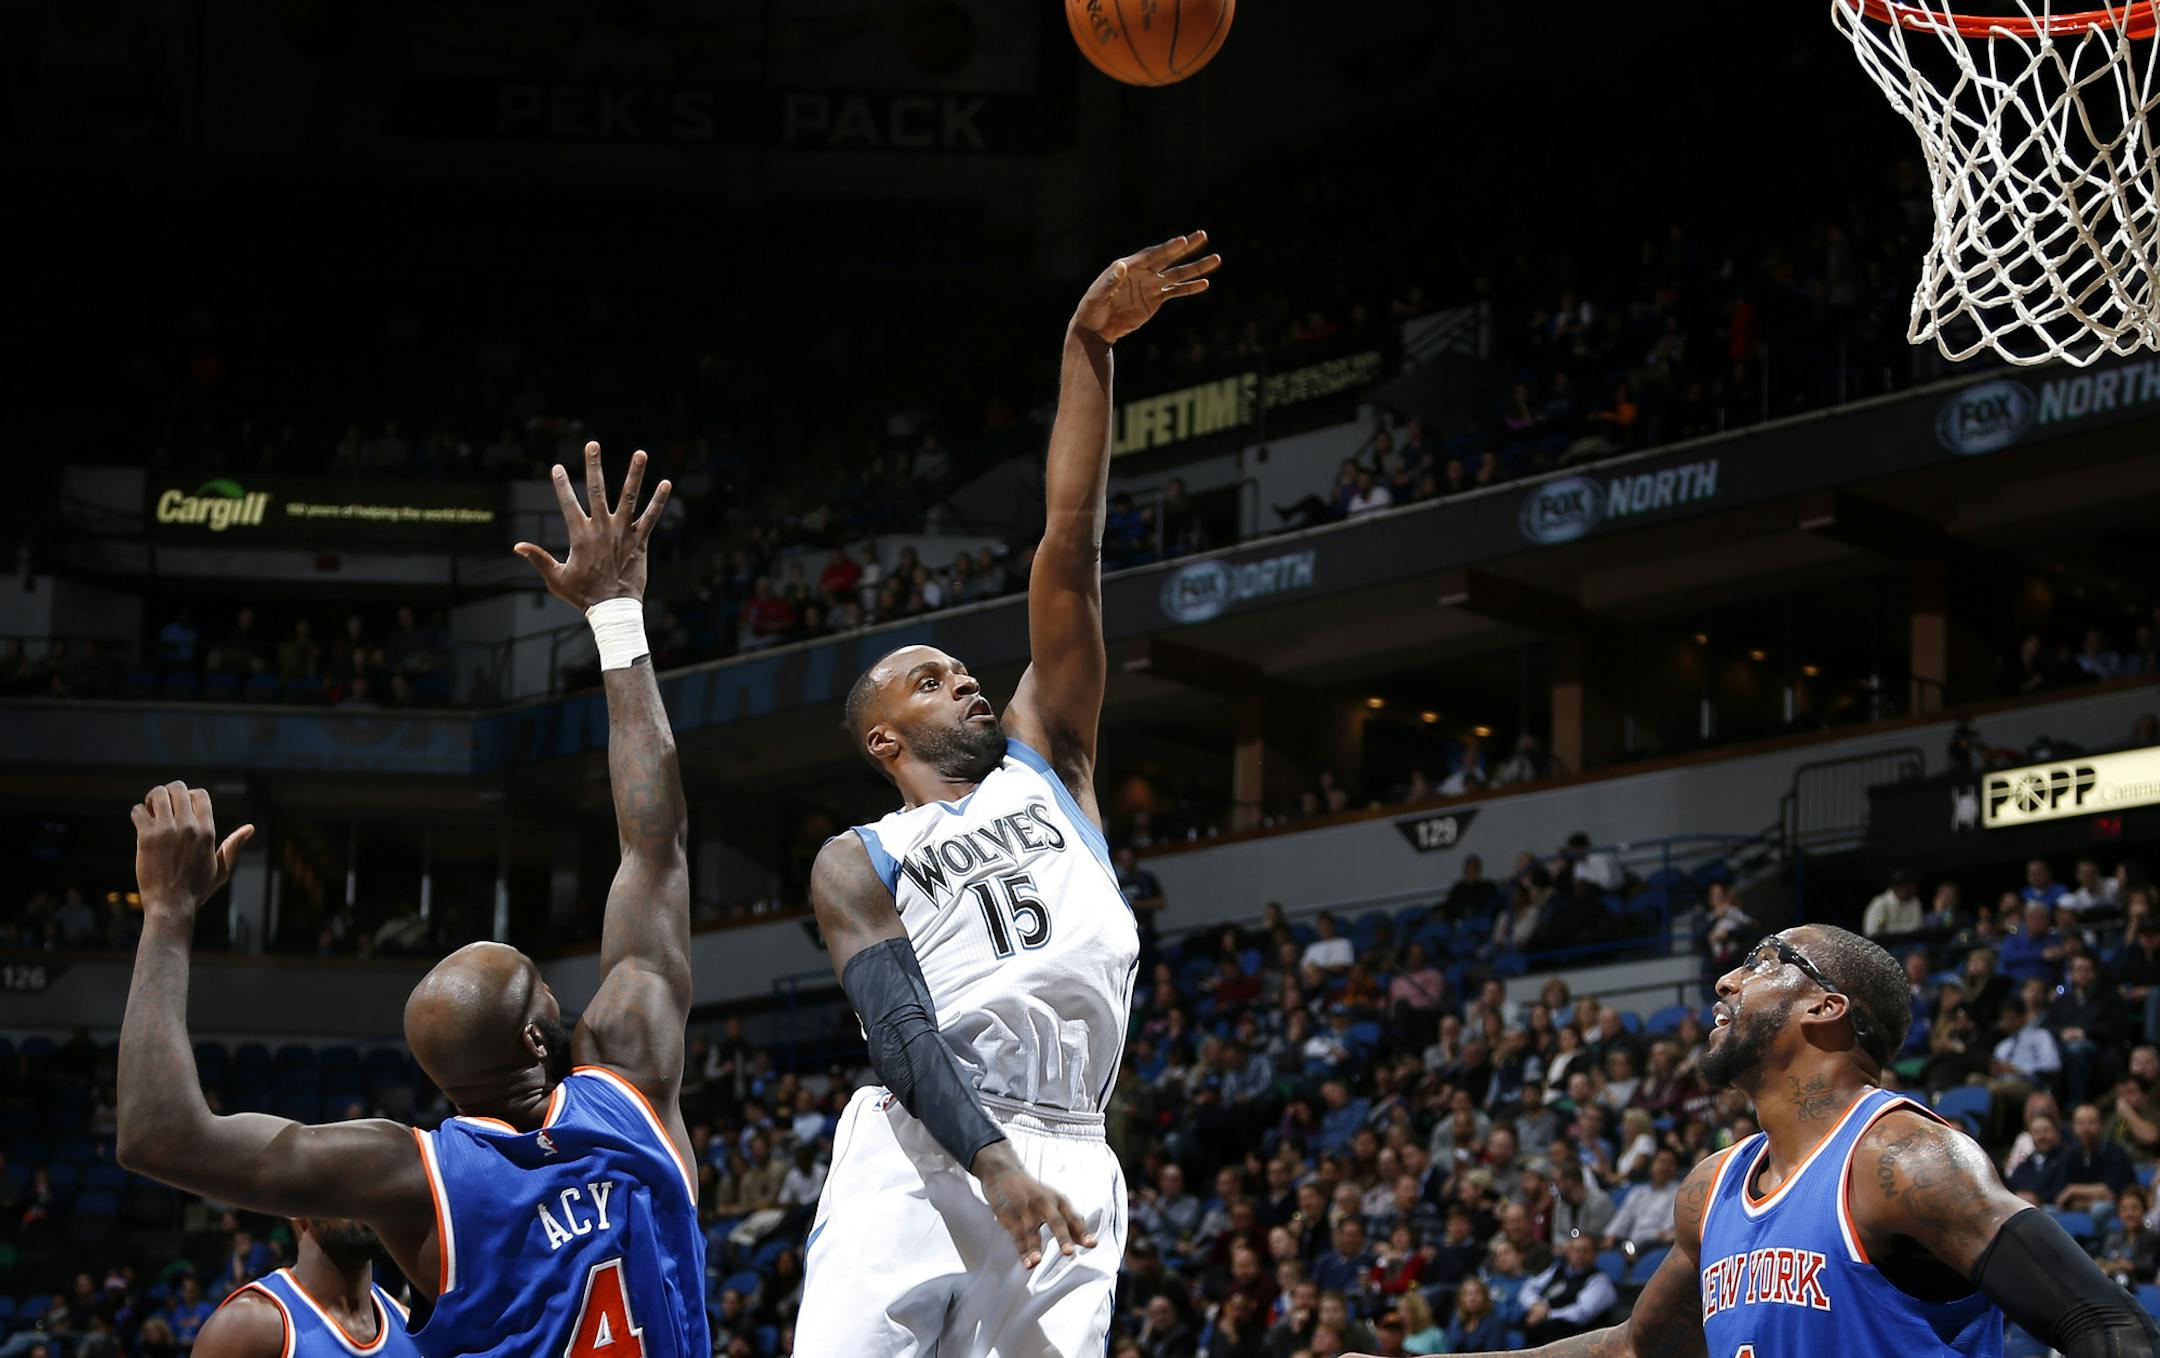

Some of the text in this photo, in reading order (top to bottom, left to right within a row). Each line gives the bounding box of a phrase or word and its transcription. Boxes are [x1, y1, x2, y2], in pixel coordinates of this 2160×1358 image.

[498, 84, 986, 149] PEK'S PACK
[1959, 361, 2160, 428] FOX NORTH
[156, 488, 270, 532] Cargill
[1606, 458, 1719, 521] NORTH
[1234, 551, 1316, 599] ORTH
[1991, 767, 2096, 818] POPP
[902, 802, 1068, 911] WOLVES
[1416, 816, 1458, 849] 129
[965, 871, 1052, 960] 15
[1, 965, 47, 991] 126
[537, 1181, 613, 1250] ACY
[564, 1256, 647, 1358] 4
[1745, 1247, 1832, 1311] YORK
